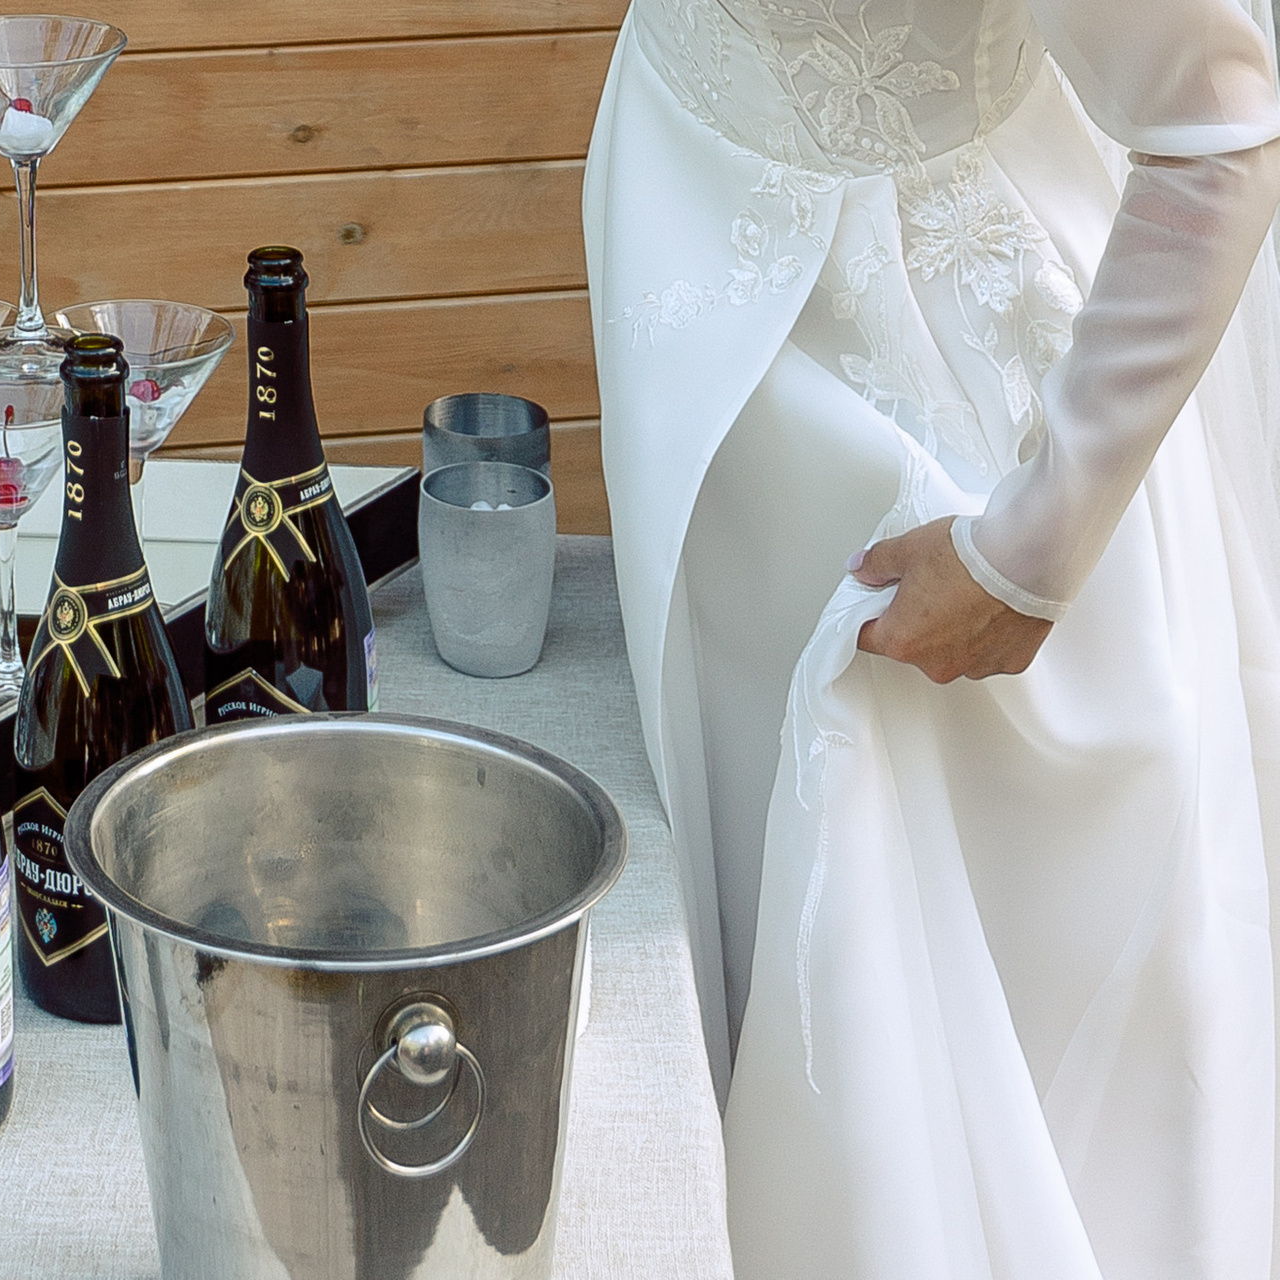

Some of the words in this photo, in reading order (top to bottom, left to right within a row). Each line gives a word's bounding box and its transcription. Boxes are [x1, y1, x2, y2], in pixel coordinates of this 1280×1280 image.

[256, 346, 277, 421] 1870
[66, 440, 85, 522] 1870
[218, 701, 247, 717] РУССКОЕ
[31, 838, 58, 857] 1870
